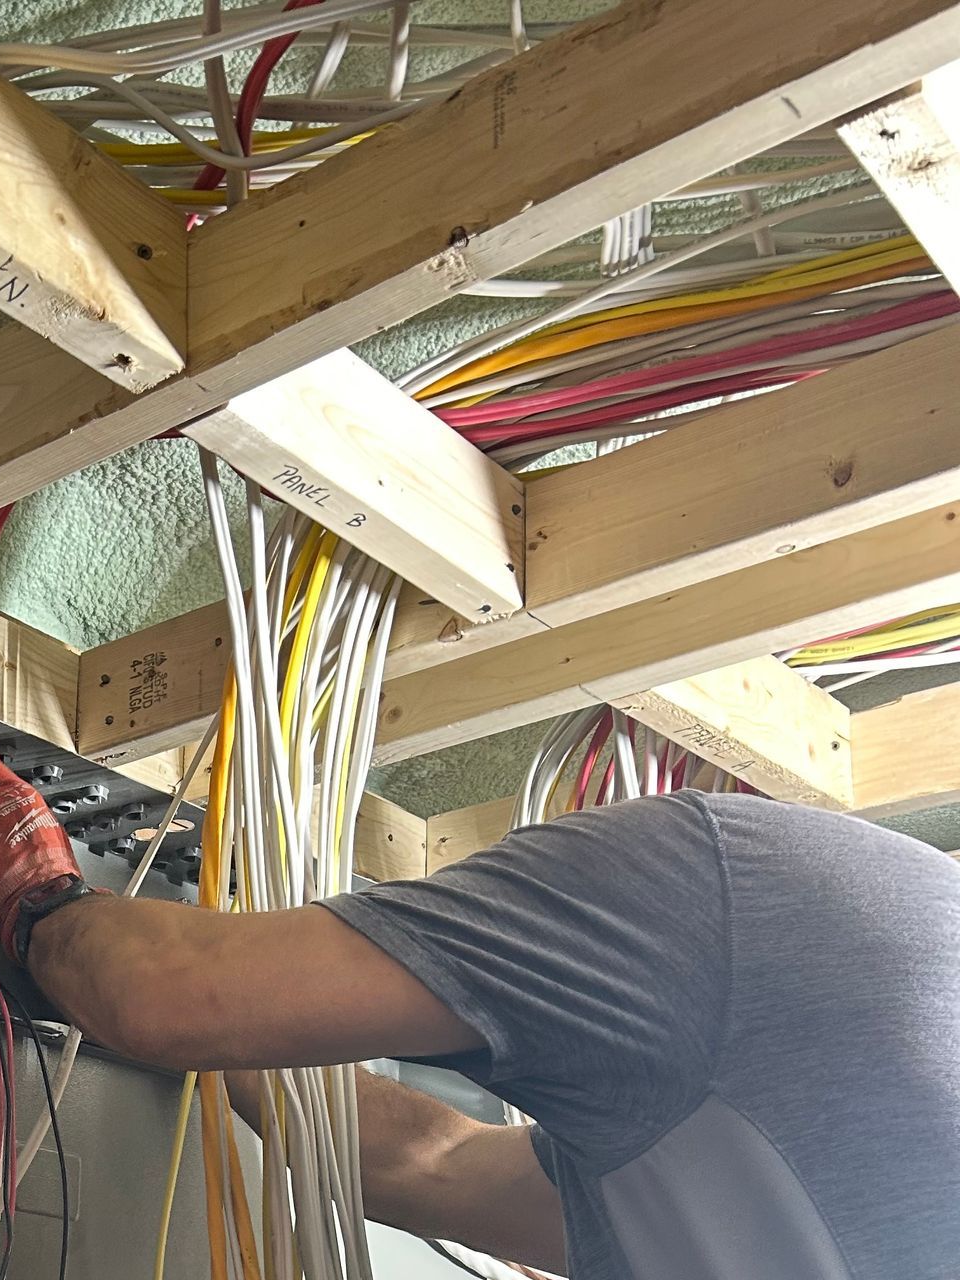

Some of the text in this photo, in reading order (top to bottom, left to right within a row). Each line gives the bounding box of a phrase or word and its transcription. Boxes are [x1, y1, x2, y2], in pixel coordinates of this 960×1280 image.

[272, 464, 367, 527] PANEL B
[129, 660, 143, 714] 4-1 NLGA
[142, 675, 154, 709] STUD
[673, 723, 756, 772] PANEL A
[8, 812, 60, 849] Milwaukee
